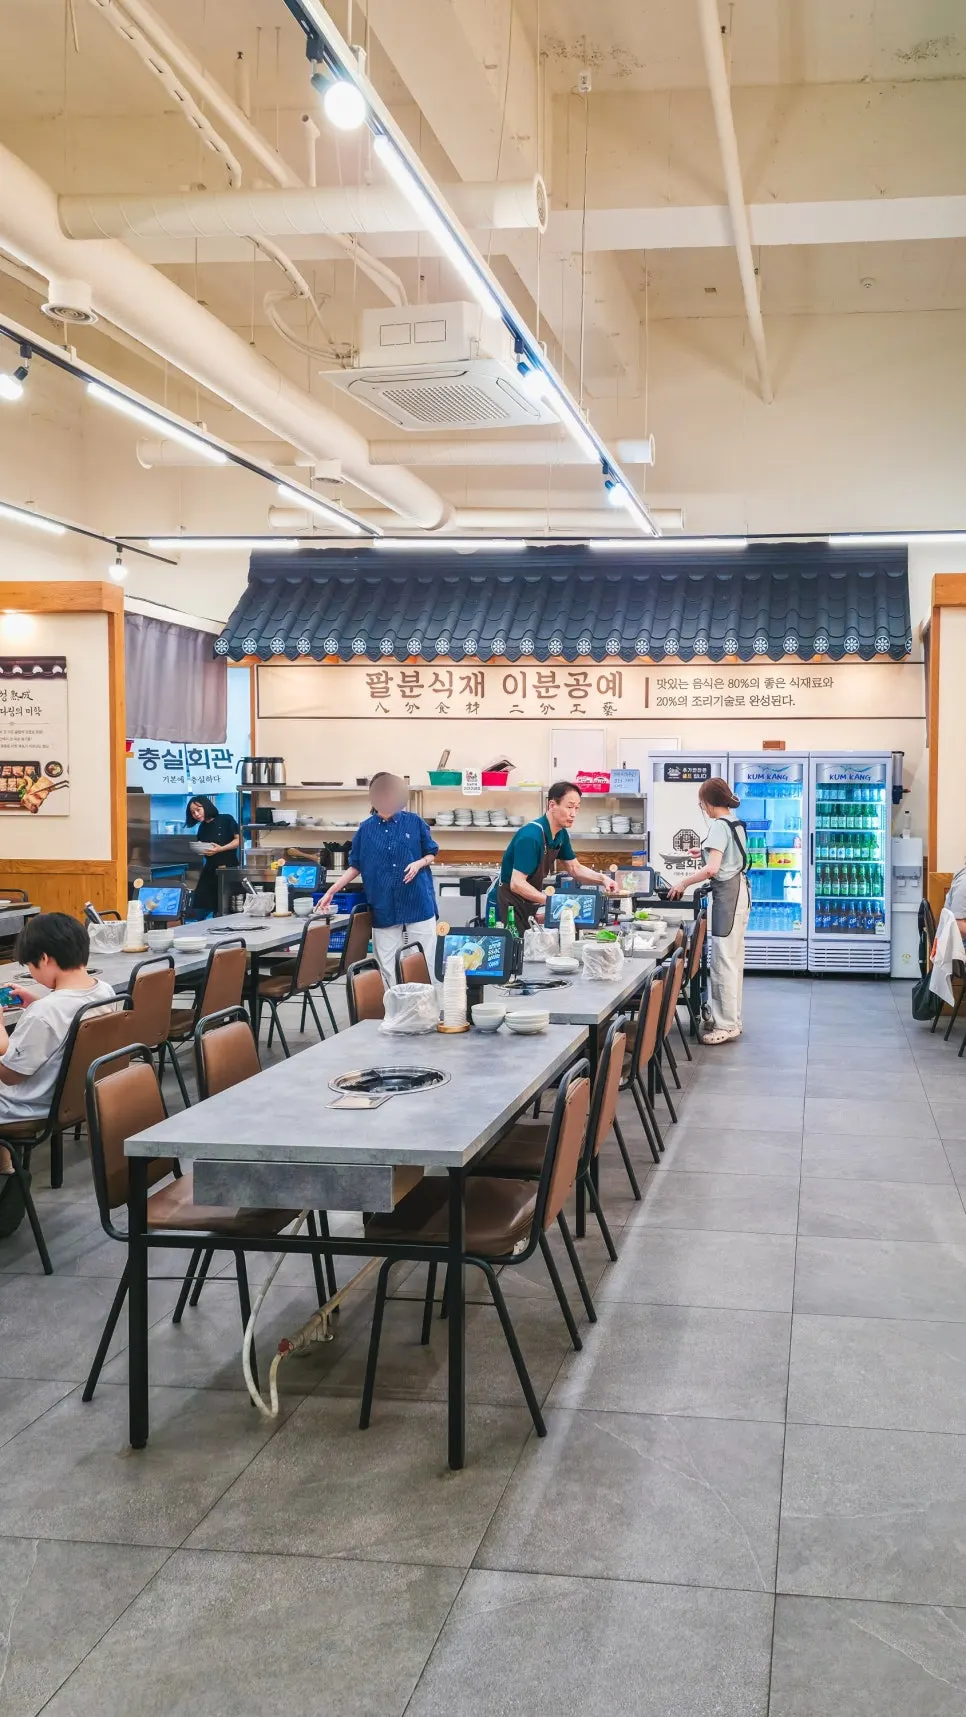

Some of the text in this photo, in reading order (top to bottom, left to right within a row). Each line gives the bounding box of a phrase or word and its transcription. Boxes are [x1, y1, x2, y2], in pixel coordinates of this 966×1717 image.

[365, 669, 623, 699] 팔분식재 이분공예
[656, 677, 834, 690] 맛있는 음식은 80%의 좋은 식재료와
[656, 695, 796, 707] 20%의 조리기술로 완성된다.
[25, 706, 42, 717] 미학
[138, 748, 234, 771] 충실회관
[162, 774, 221, 785] 기본에 충실하다
[747, 773, 788, 782] KUM KANG
[849, 774, 871, 782] KANG
